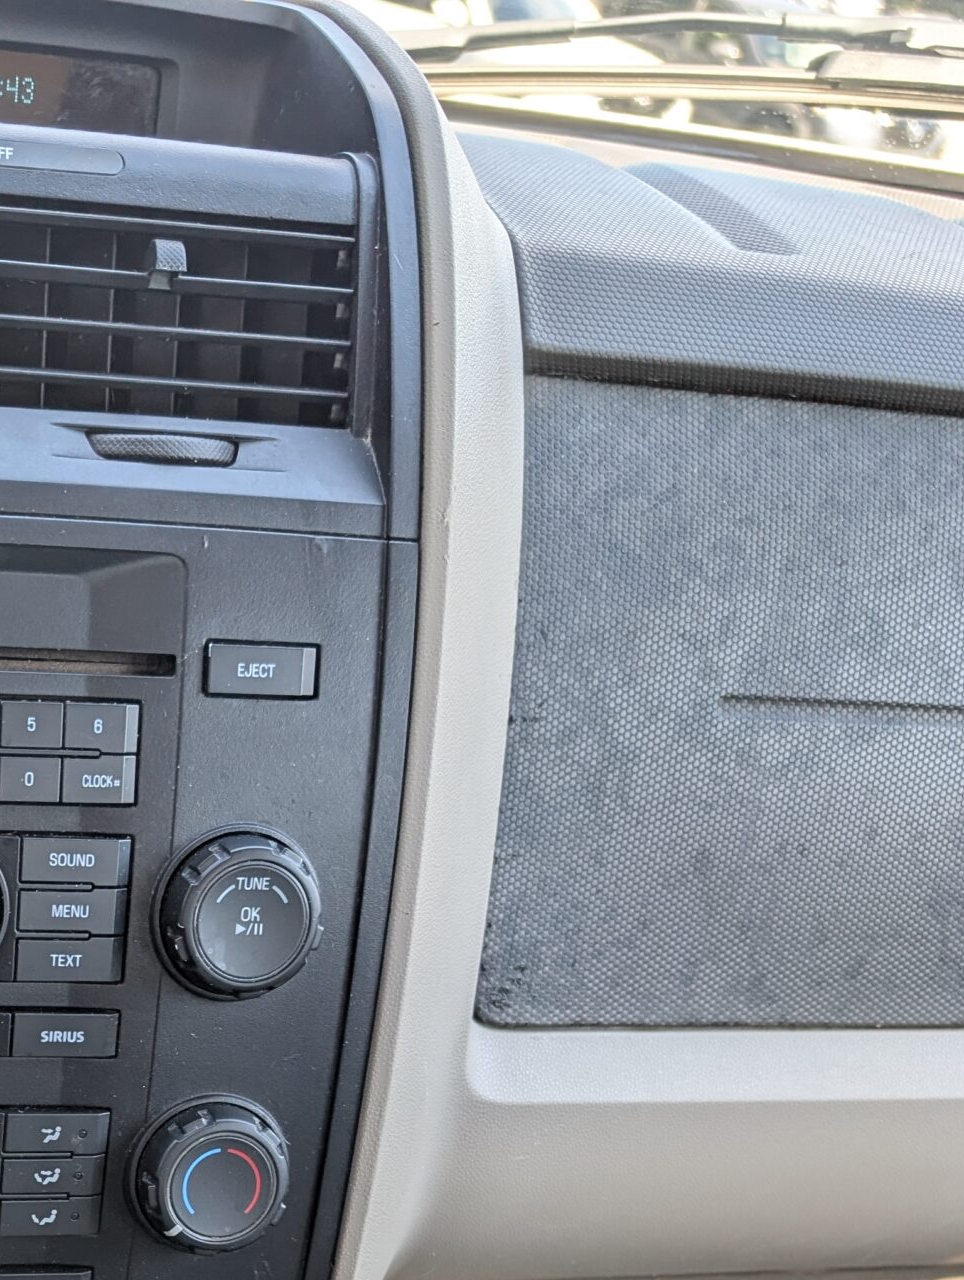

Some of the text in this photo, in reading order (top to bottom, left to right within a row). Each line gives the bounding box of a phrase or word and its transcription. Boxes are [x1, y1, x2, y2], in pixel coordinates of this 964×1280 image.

[237, 662, 276, 678] EJECT
[27, 716, 36, 732] 5
[93, 718, 103, 734] 6
[49, 852, 95, 868] SOUND
[236, 876, 271, 891] TUNE
[51, 904, 90, 918] MENU
[240, 906, 261, 922] OK
[50, 954, 83, 967] TEXT
[40, 1030, 85, 1043] SIRIUS
